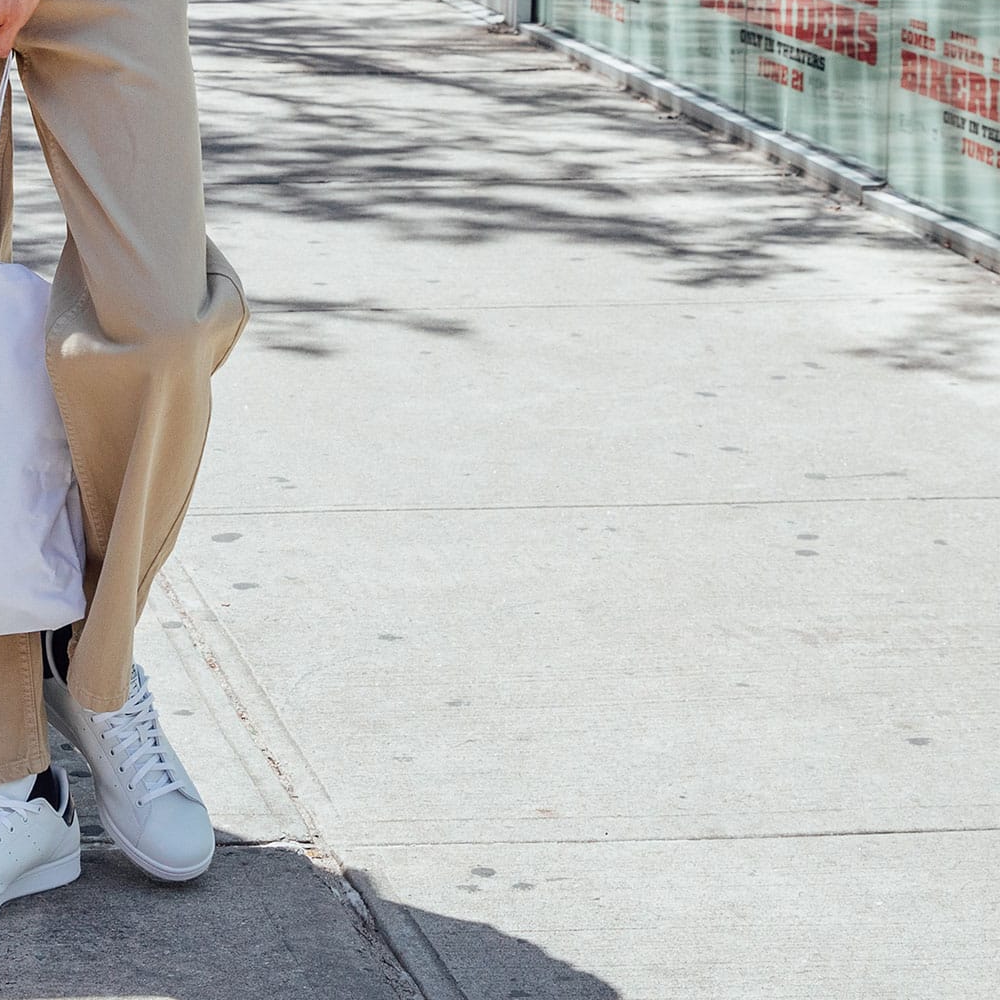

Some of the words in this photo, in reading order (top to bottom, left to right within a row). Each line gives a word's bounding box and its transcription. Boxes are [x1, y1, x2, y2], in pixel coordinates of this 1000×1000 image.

[901, 28, 936, 51] COMER
[943, 42, 985, 68] BUTLER
[791, 69, 804, 92] 21
[962, 138, 994, 165] JUNE
